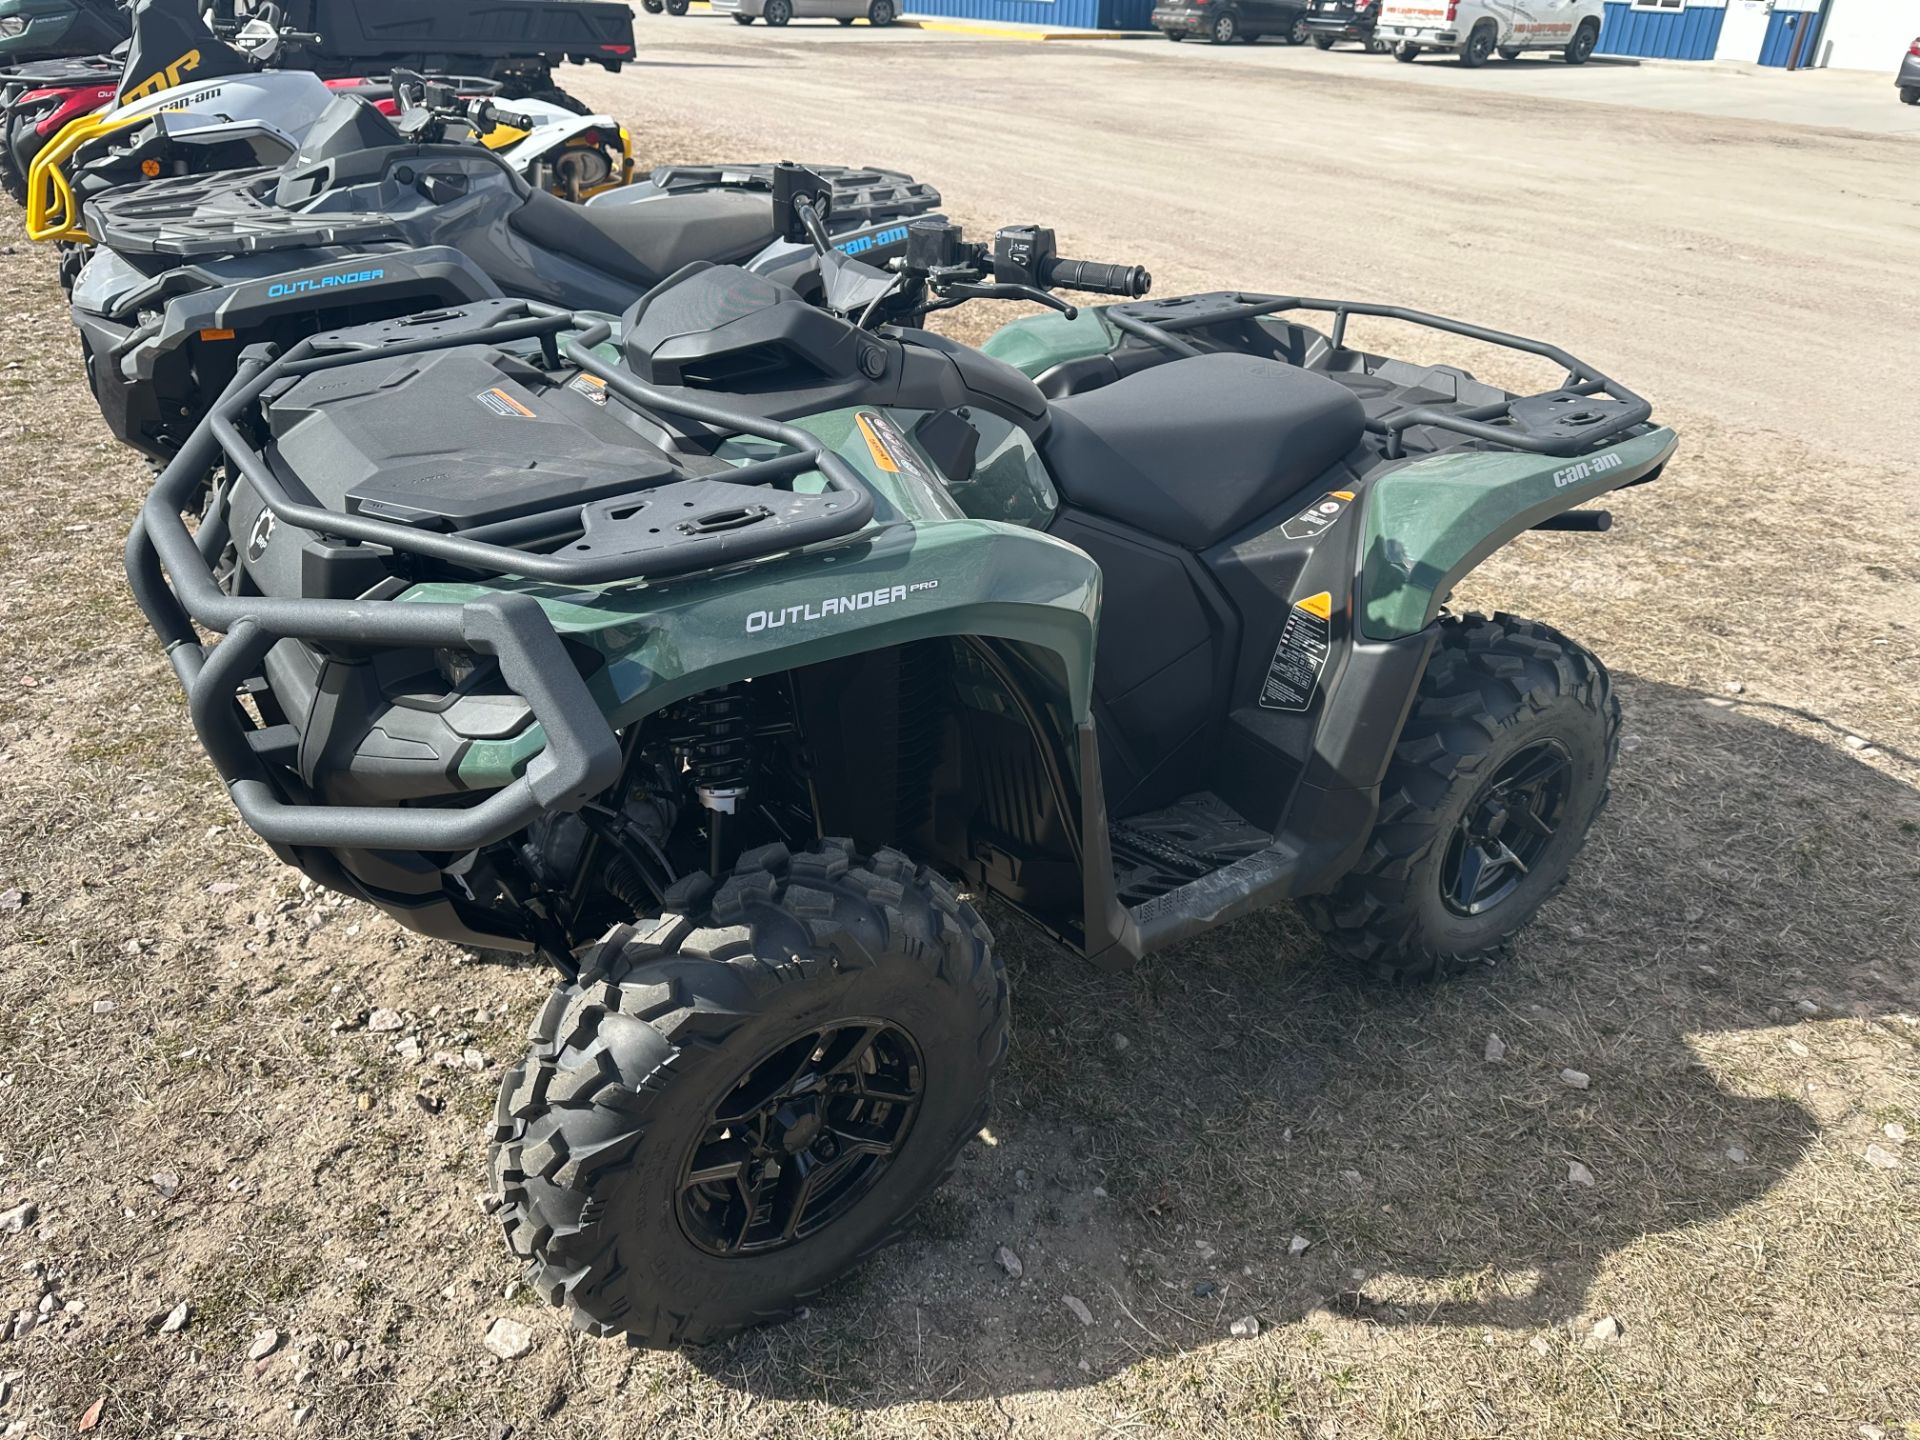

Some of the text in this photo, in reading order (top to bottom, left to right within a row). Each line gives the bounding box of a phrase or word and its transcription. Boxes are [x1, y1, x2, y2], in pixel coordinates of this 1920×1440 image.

[267, 269, 384, 298] OUTLANDER
[1552, 452, 1623, 488] can-am
[745, 579, 938, 633] OUTLANDER PRO
